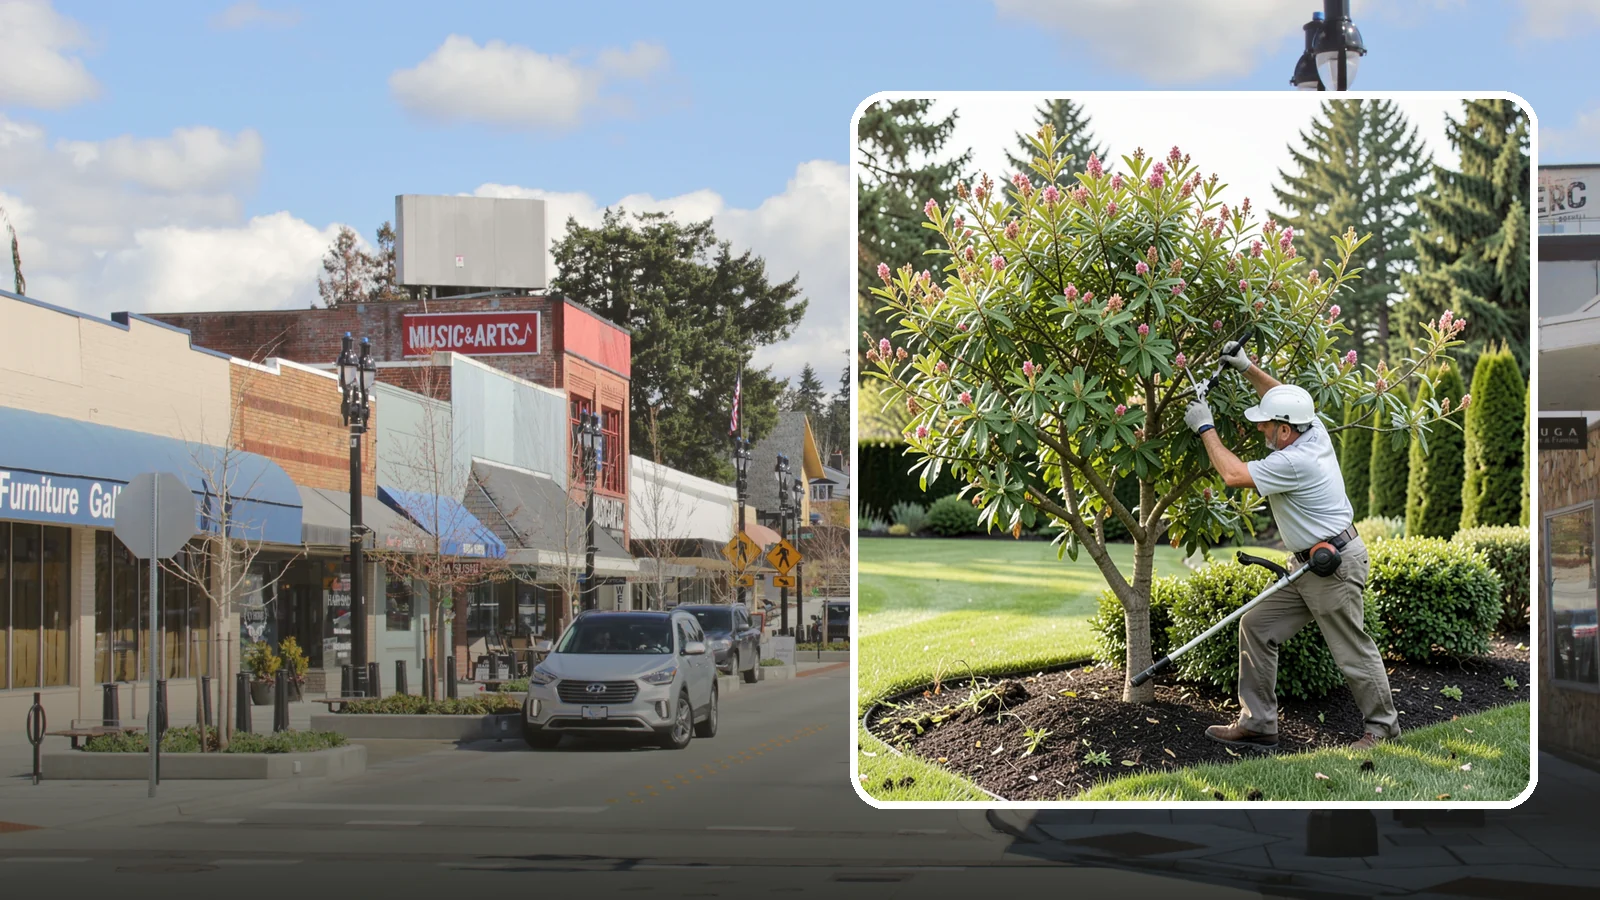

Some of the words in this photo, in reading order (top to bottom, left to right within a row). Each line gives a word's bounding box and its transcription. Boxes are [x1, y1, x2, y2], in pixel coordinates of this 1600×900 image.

[1538, 181, 1587, 213] ERC
[408, 322, 520, 349] MUSIC&ARTS
[0, 471, 79, 515] Furniture
[89, 482, 122, 519] Gal
[453, 563, 479, 574] SUSHI
